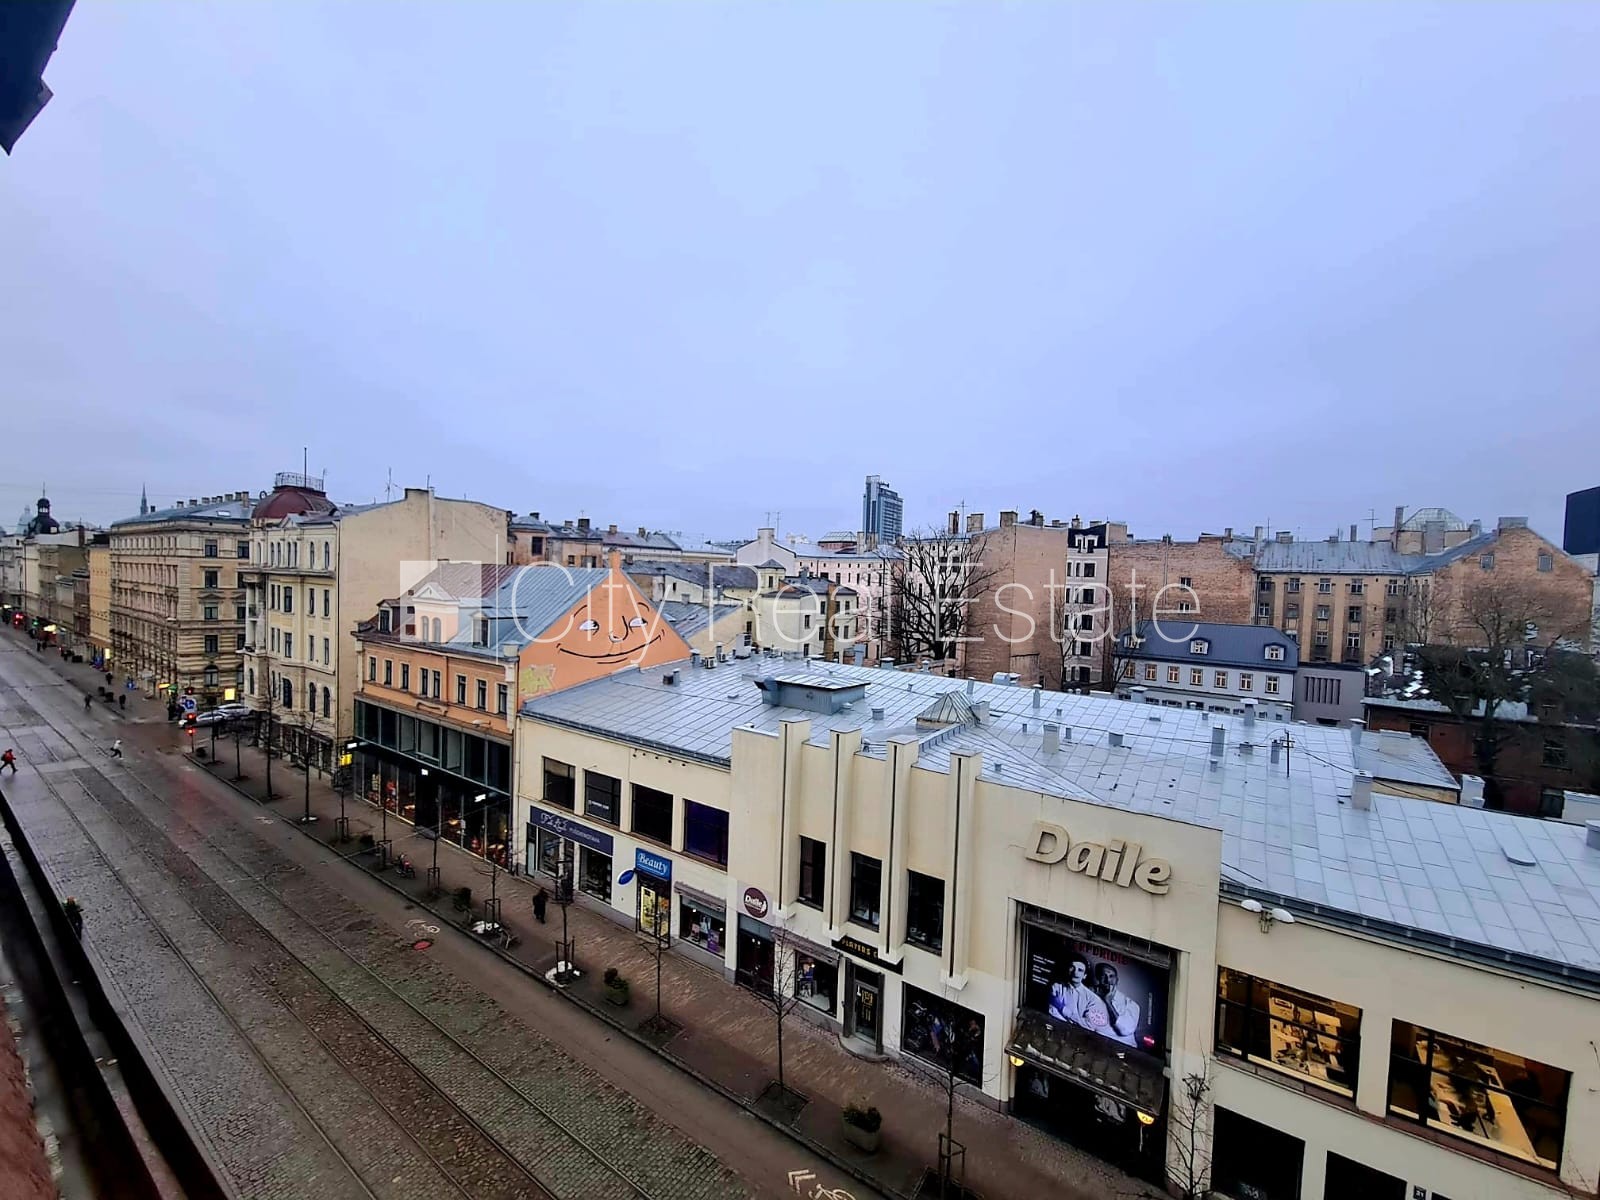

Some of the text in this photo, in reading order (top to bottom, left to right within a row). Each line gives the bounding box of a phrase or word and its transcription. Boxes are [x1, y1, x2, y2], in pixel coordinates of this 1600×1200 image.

[639, 852, 668, 874] Beauty
[1025, 821, 1172, 895] Daile
[841, 939, 871, 956] PLAYERS
